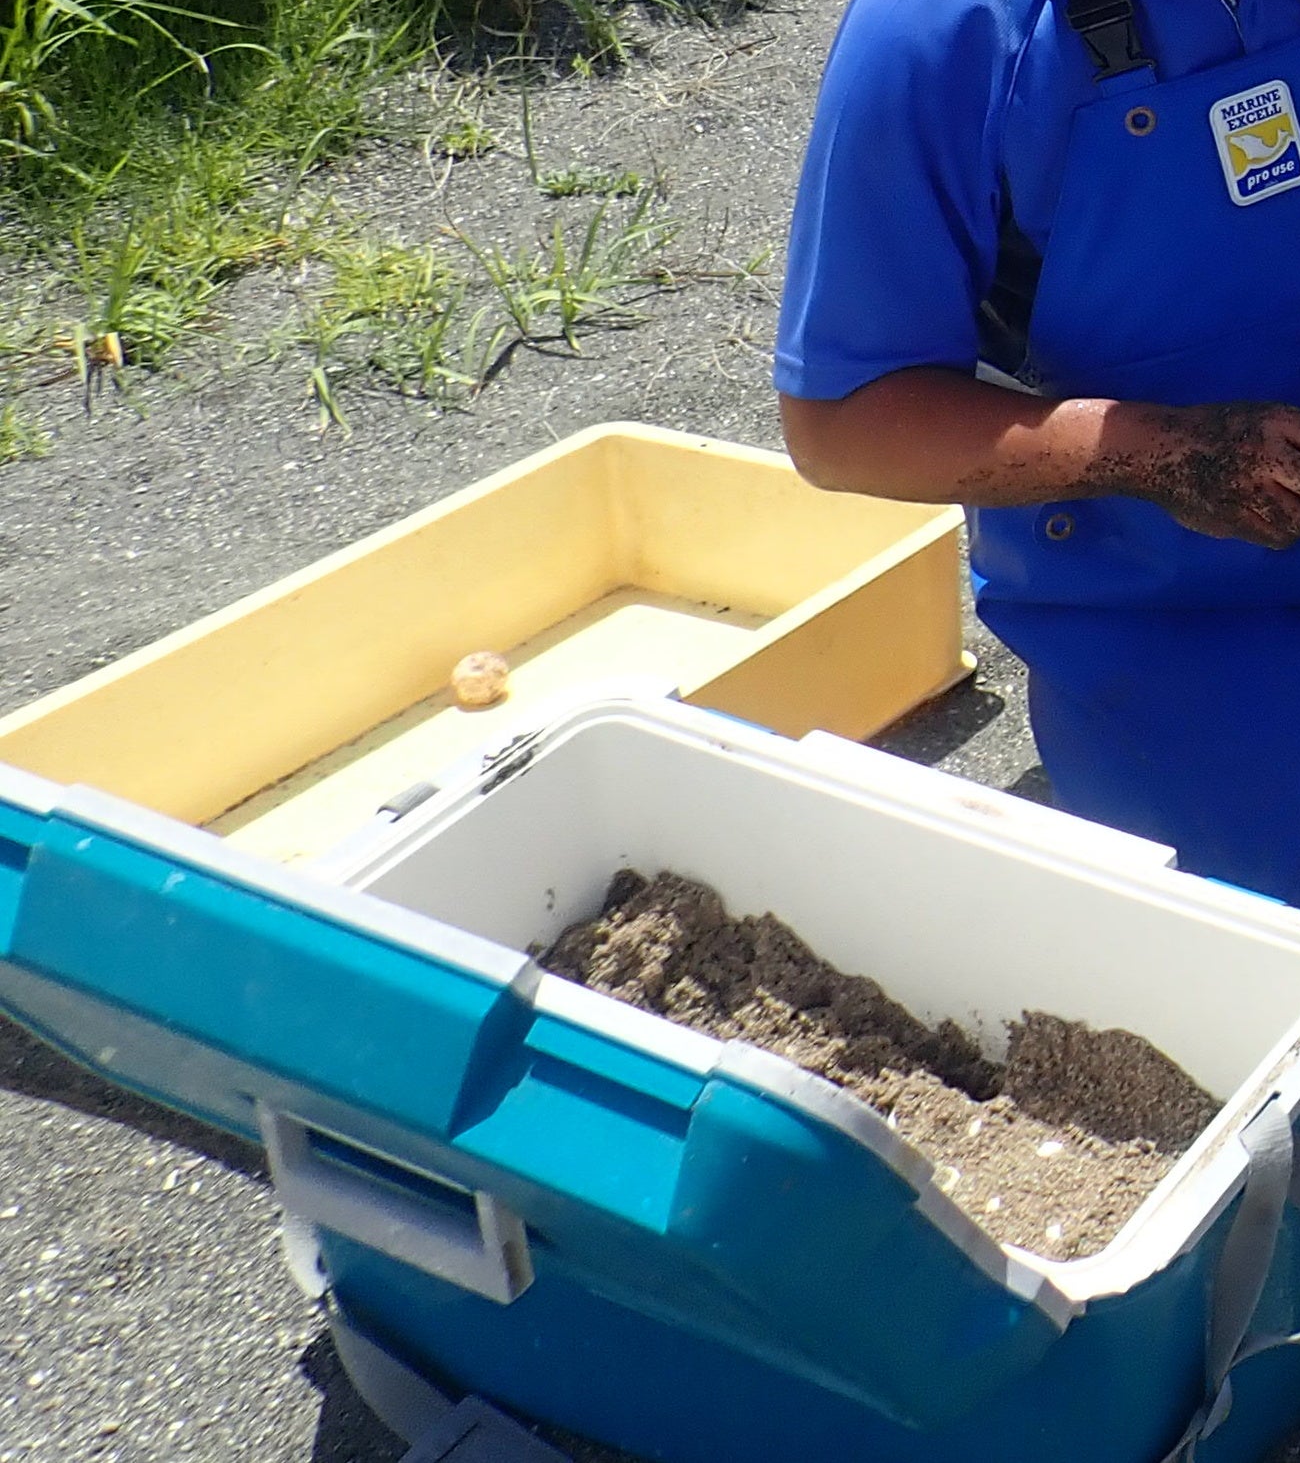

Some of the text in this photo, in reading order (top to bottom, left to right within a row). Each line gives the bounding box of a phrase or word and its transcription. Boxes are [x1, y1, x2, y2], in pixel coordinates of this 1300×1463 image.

[1220, 88, 1281, 120] MARINE
[1226, 103, 1282, 132] EXCELL
[1246, 160, 1295, 191] pro use
